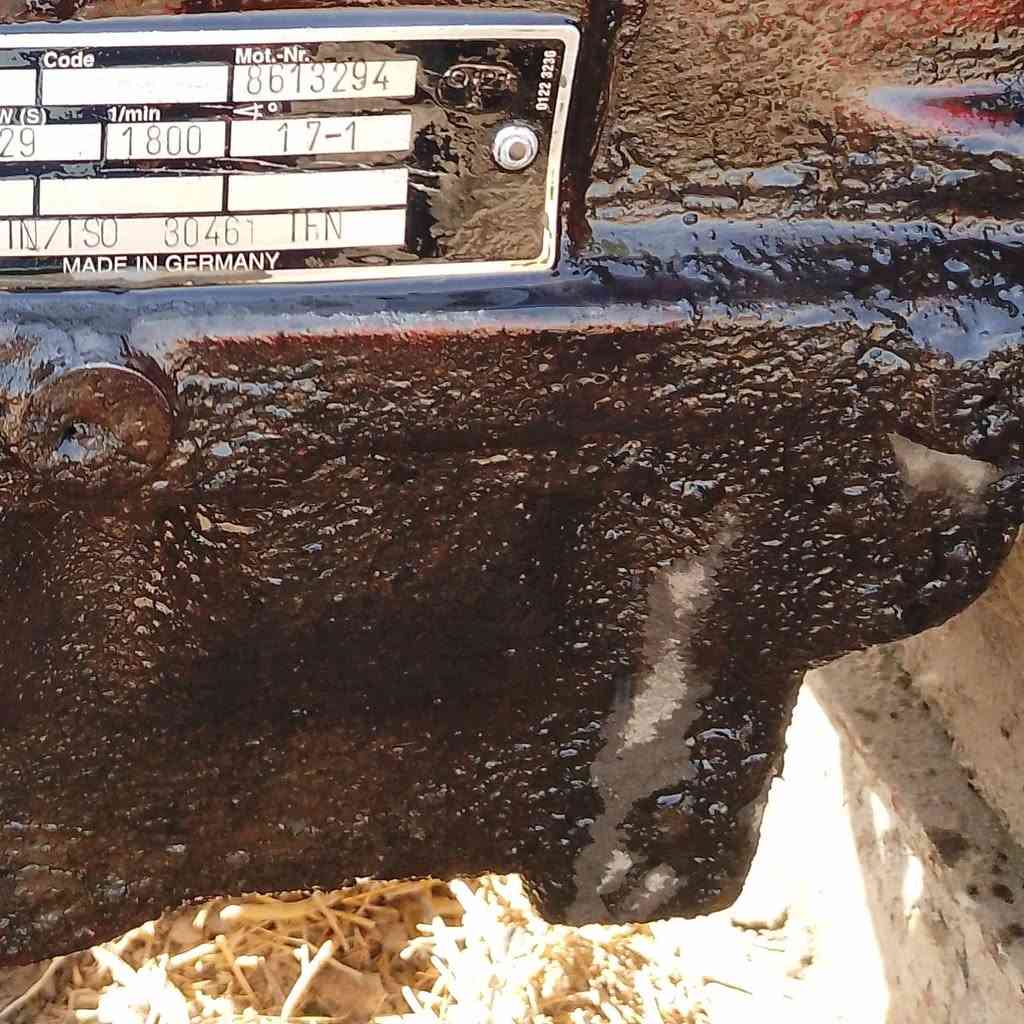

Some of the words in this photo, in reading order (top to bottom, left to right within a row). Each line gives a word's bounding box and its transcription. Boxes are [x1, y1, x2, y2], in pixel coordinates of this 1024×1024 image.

[43, 51, 95, 68] Code
[235, 47, 311, 65] Mot.-Nr.
[247, 61, 390, 95] 8613294
[20, 107, 47, 125] (S)
[108, 105, 161, 123] 1/min
[0, 127, 35, 158] 29
[122, 125, 202, 156] 1800
[63, 255, 128, 274] MADE
[136, 255, 158, 273] IN
[165, 251, 281, 273] GERMANY
